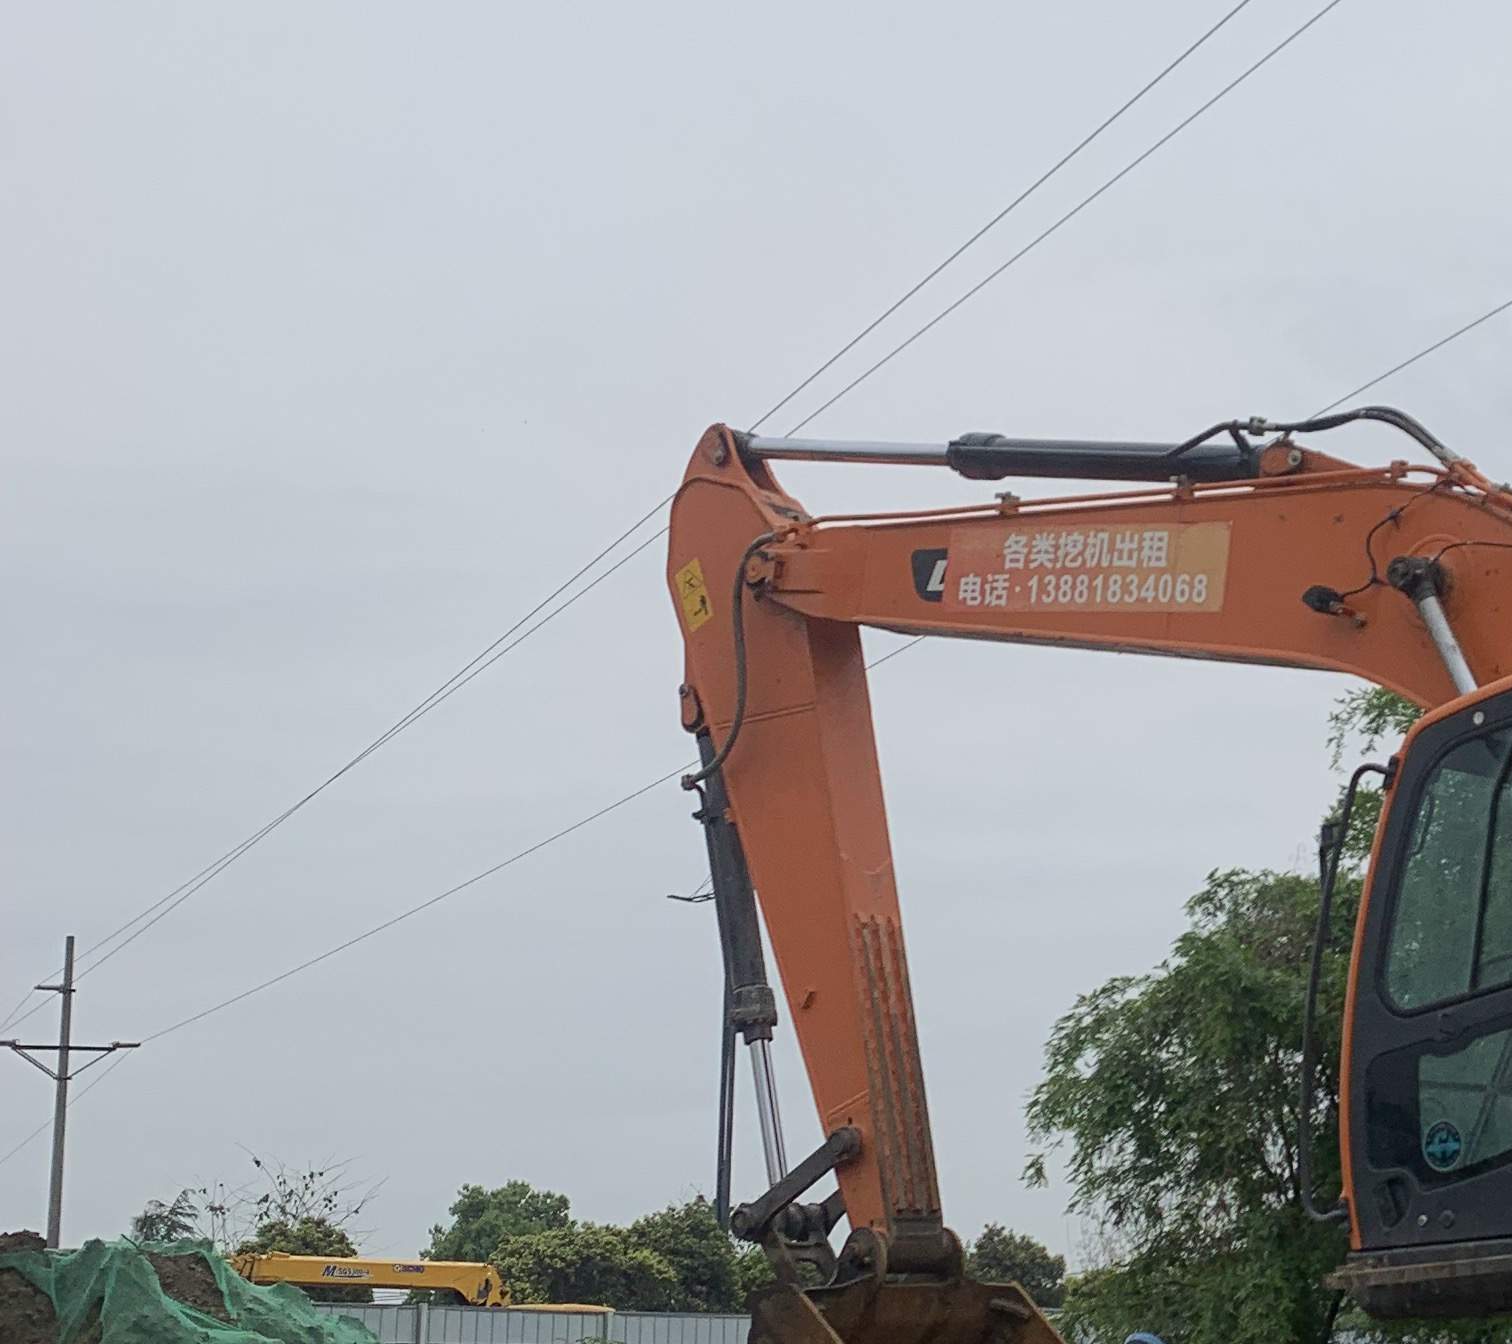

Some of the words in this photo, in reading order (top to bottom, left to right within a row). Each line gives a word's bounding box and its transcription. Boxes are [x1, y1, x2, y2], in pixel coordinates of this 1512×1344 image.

[1003, 531, 1169, 569] 各类挖机出租
